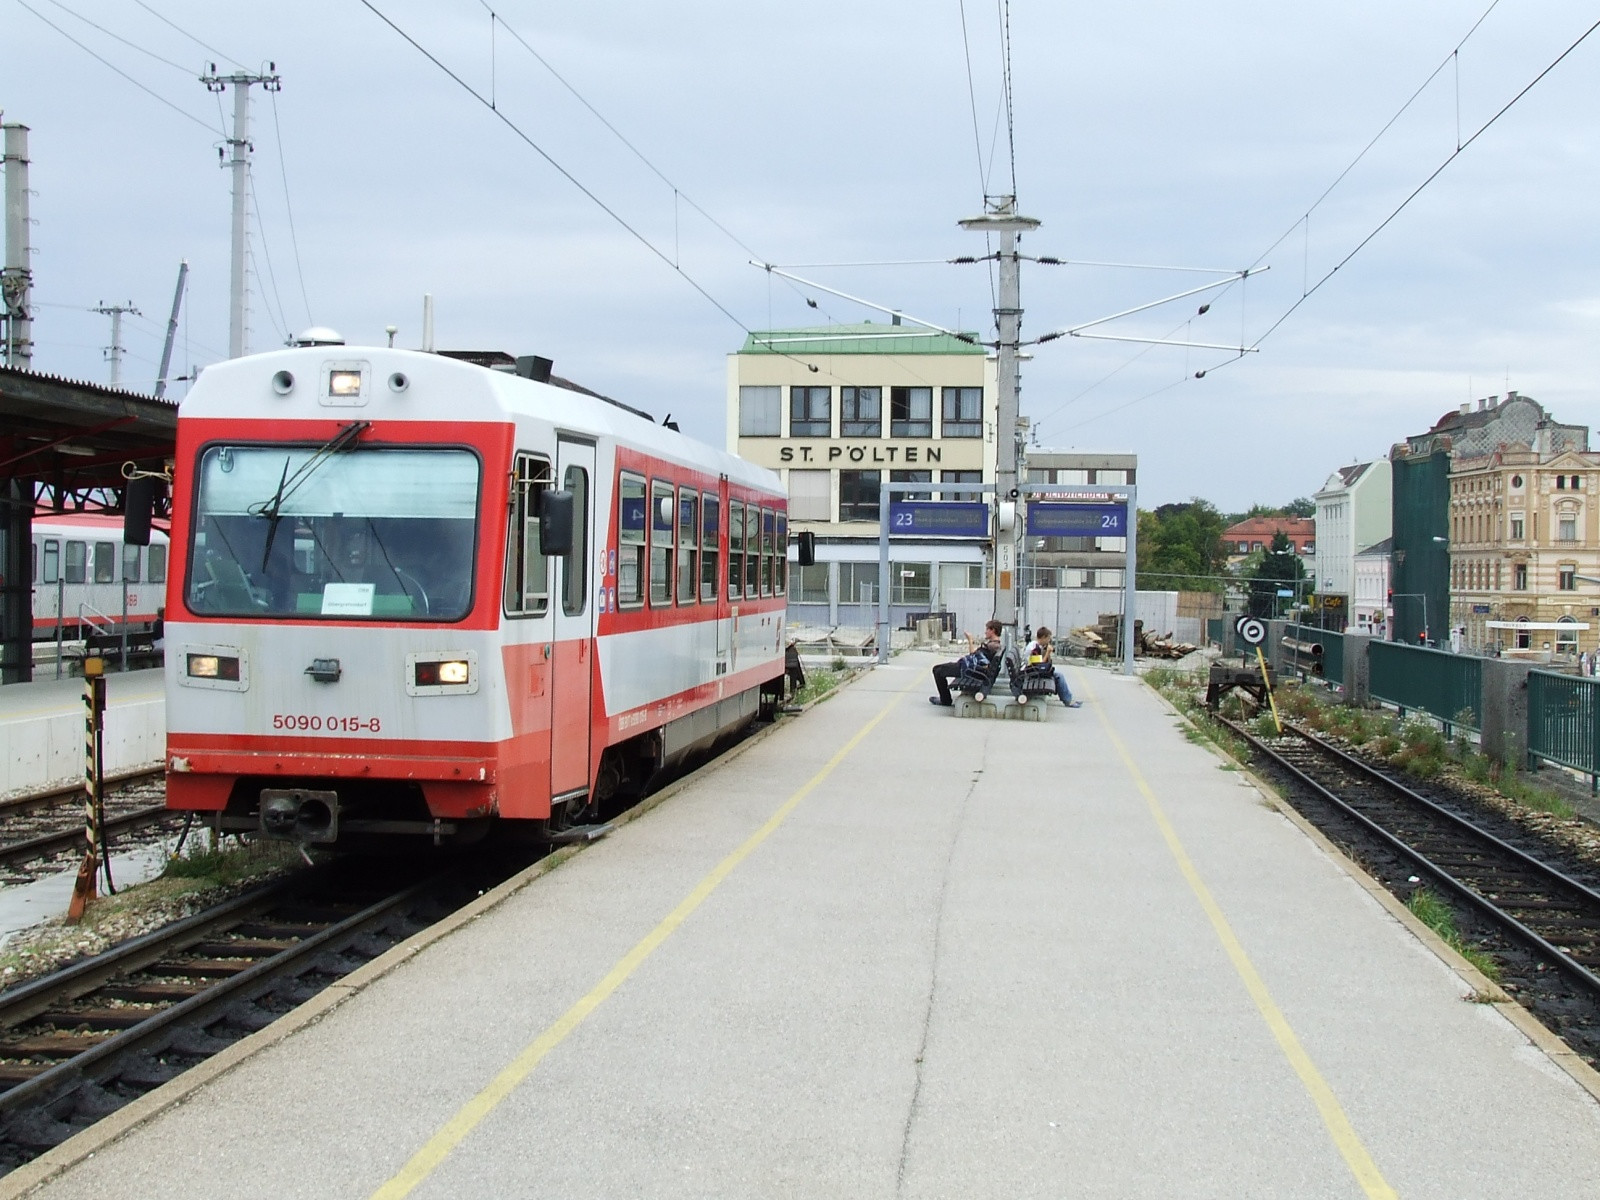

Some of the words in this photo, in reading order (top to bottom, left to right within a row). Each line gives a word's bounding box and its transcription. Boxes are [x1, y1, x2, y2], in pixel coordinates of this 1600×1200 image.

[780, 446, 814, 462] ST.
[828, 445, 942, 462] PÖLTEN
[896, 513, 913, 527] 23
[1101, 515, 1119, 529] 24
[87, 544, 94, 567] 2
[273, 714, 323, 731] 5090
[326, 715, 382, 733] 015-8
